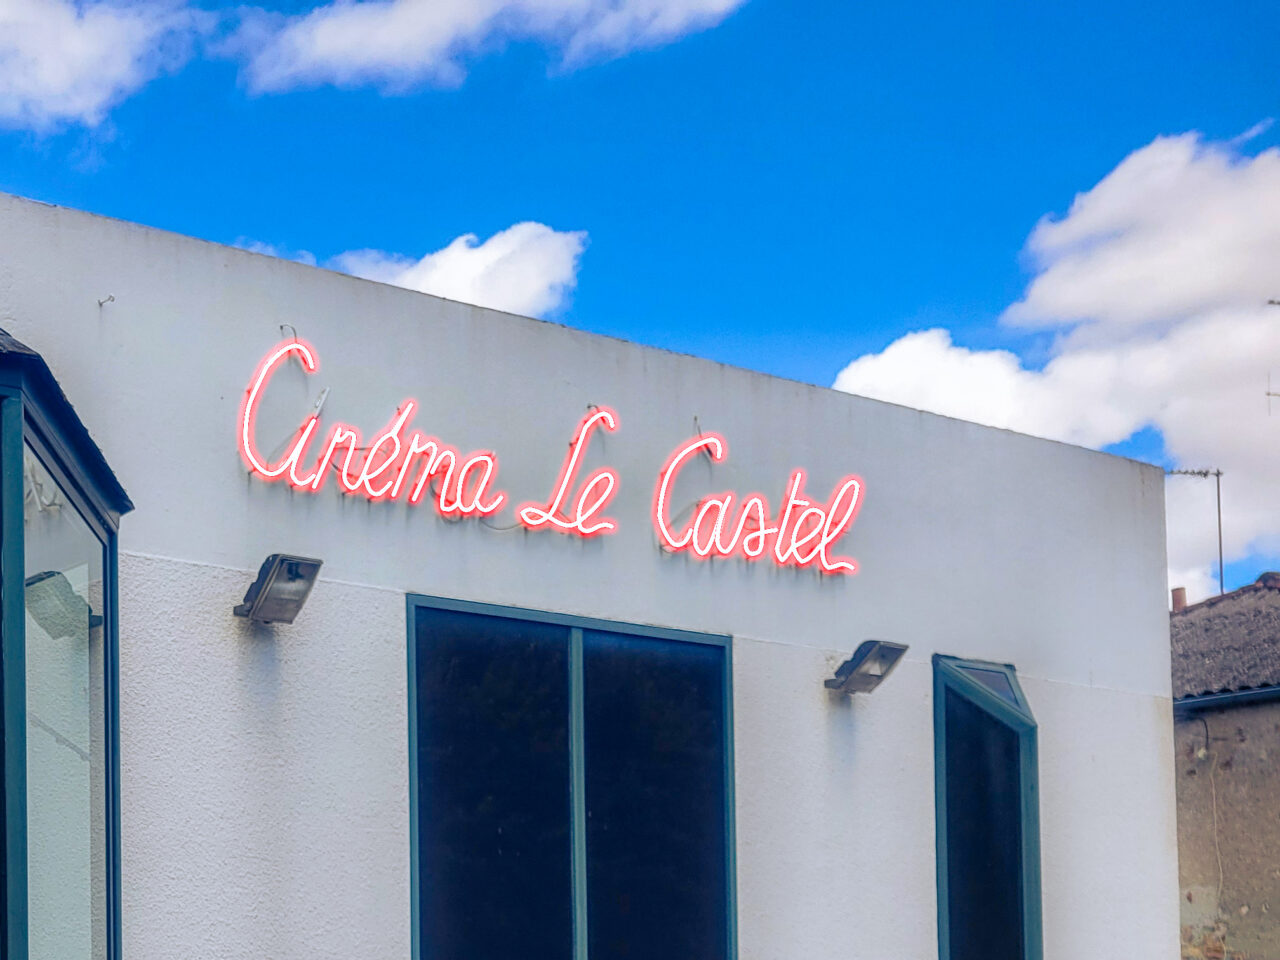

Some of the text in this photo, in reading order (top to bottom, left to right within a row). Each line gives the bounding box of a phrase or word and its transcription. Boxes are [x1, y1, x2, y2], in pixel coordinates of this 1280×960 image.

[239, 340, 864, 575] Cinéma Le Castel
